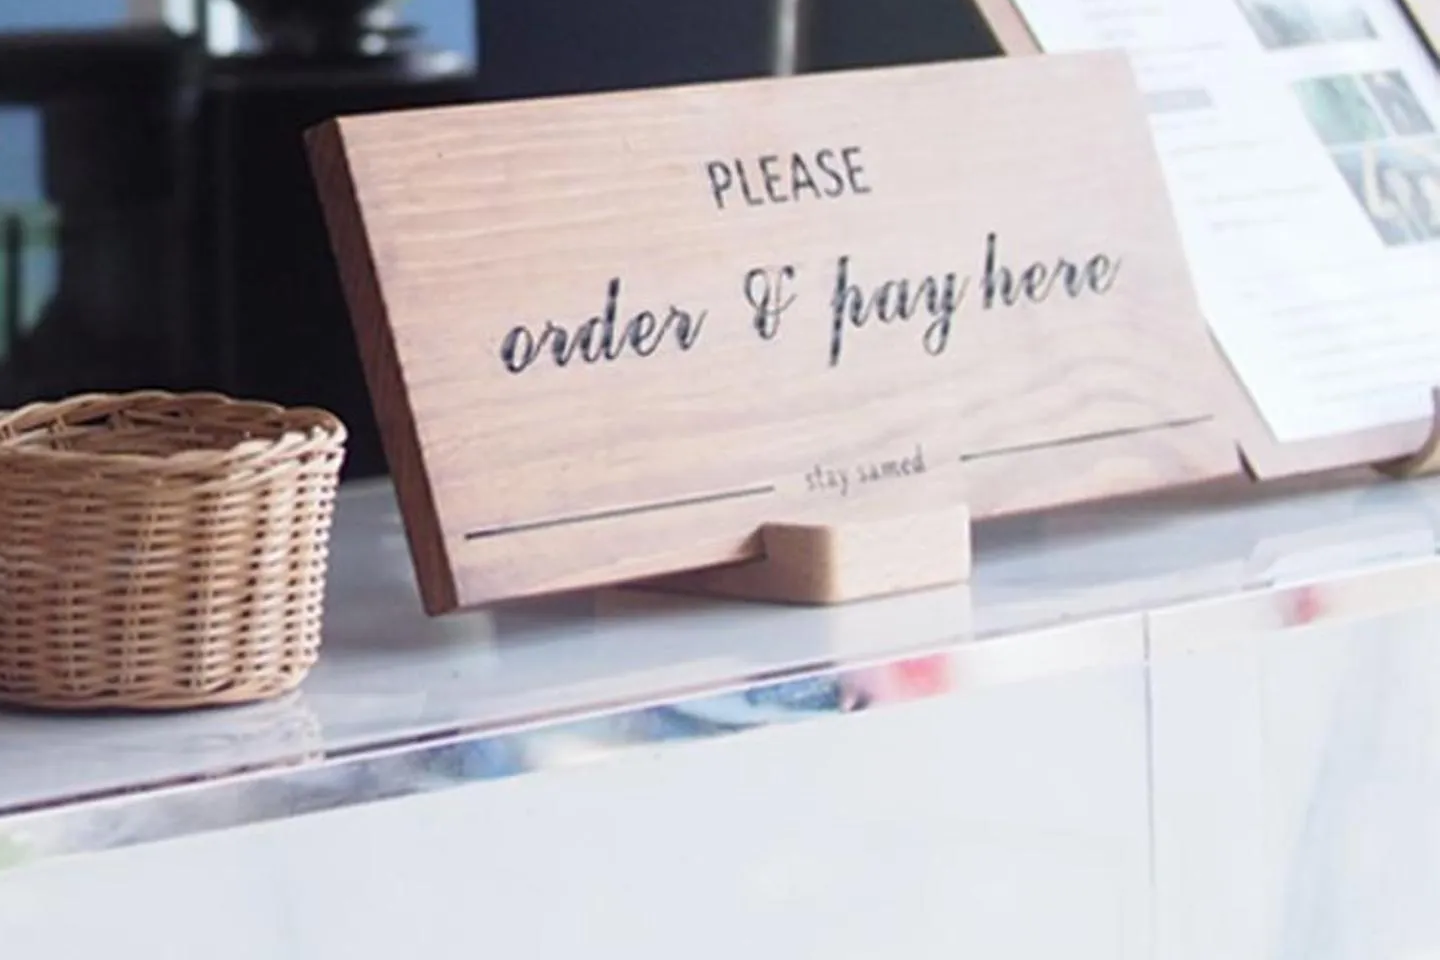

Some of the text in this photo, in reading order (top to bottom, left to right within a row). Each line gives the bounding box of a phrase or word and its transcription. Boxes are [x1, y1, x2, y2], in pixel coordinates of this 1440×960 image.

[707, 145, 872, 209] PLEASE
[501, 232, 1123, 373] order & pay here
[805, 443, 927, 497] stay samed
